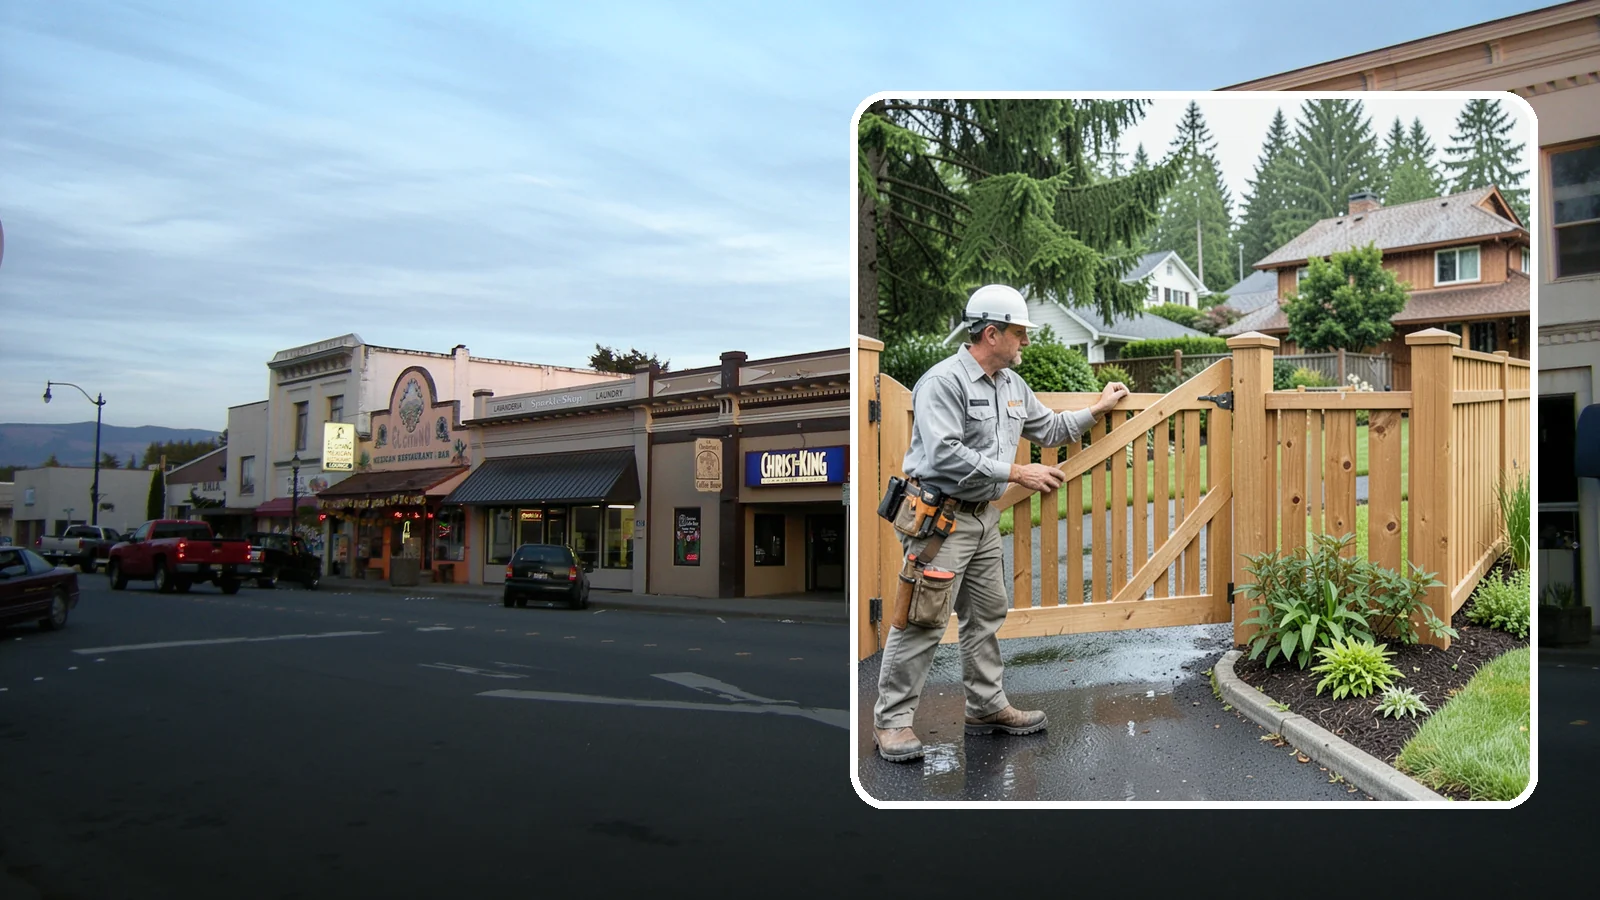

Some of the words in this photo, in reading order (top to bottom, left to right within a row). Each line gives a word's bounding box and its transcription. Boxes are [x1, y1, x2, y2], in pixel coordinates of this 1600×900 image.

[562, 394, 583, 404] Shop
[595, 389, 624, 400] LAUNDRY
[493, 401, 523, 413] LAVANDERIA
[397, 451, 433, 462] RESTAURANT
[438, 450, 450, 459] BAR
[761, 452, 797, 478] CHRIST
[799, 450, 828, 476] KING
